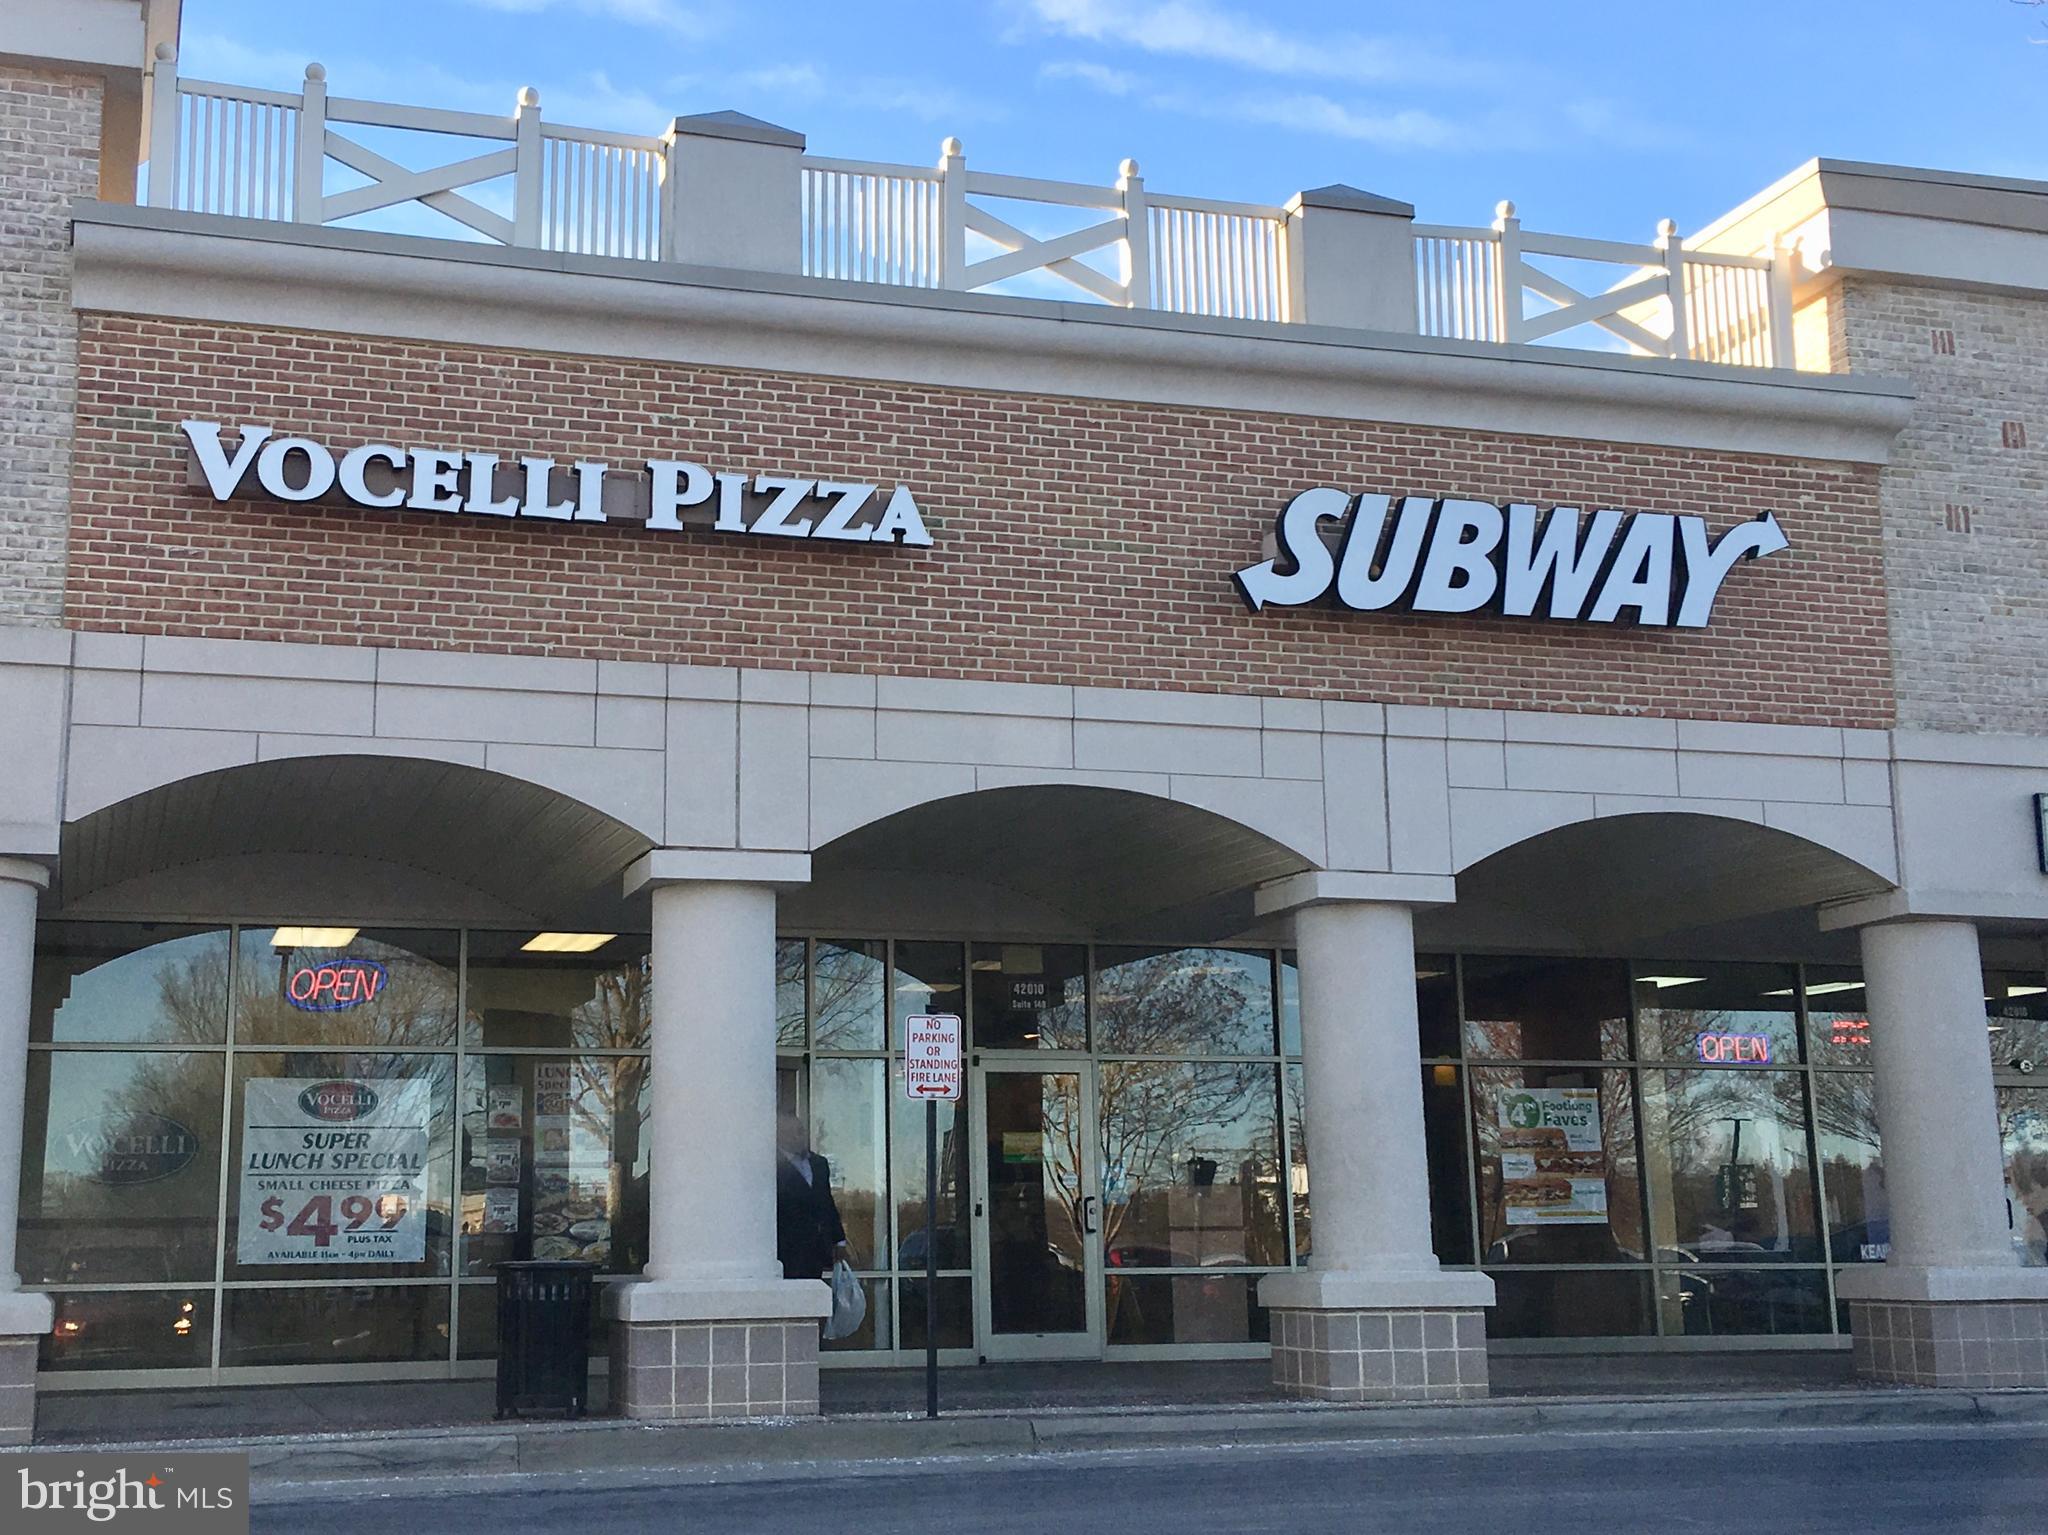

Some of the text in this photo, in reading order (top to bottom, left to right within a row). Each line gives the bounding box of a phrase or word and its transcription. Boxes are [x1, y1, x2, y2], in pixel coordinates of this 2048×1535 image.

[180, 418, 934, 547] VOCELLI PIZZA
[1236, 486, 1790, 628] SUBWAY
[291, 967, 379, 1001] OPEN
[1013, 983, 1045, 995] 42010
[926, 1019, 942, 1030] NO
[912, 1032, 955, 1044] PARKING
[926, 1046, 941, 1056] OR
[1702, 1035, 1769, 1062] OPEN
[909, 1059, 958, 1070] STANDING
[911, 1072, 957, 1083] FIRE LANE
[306, 1093, 371, 1107] VOCELLI
[1543, 1112, 1588, 1127] Faves
[302, 1132, 371, 1150] SUPER
[250, 1152, 423, 1170] LUNCH SPECIAL
[257, 1180, 304, 1191] SMALL
[309, 1180, 362, 1191] CHEESE
[347, 1234, 393, 1244] PLUS TAX
[267, 1251, 318, 1260] AVAILABLE
[367, 1250, 396, 1259] DAILY
